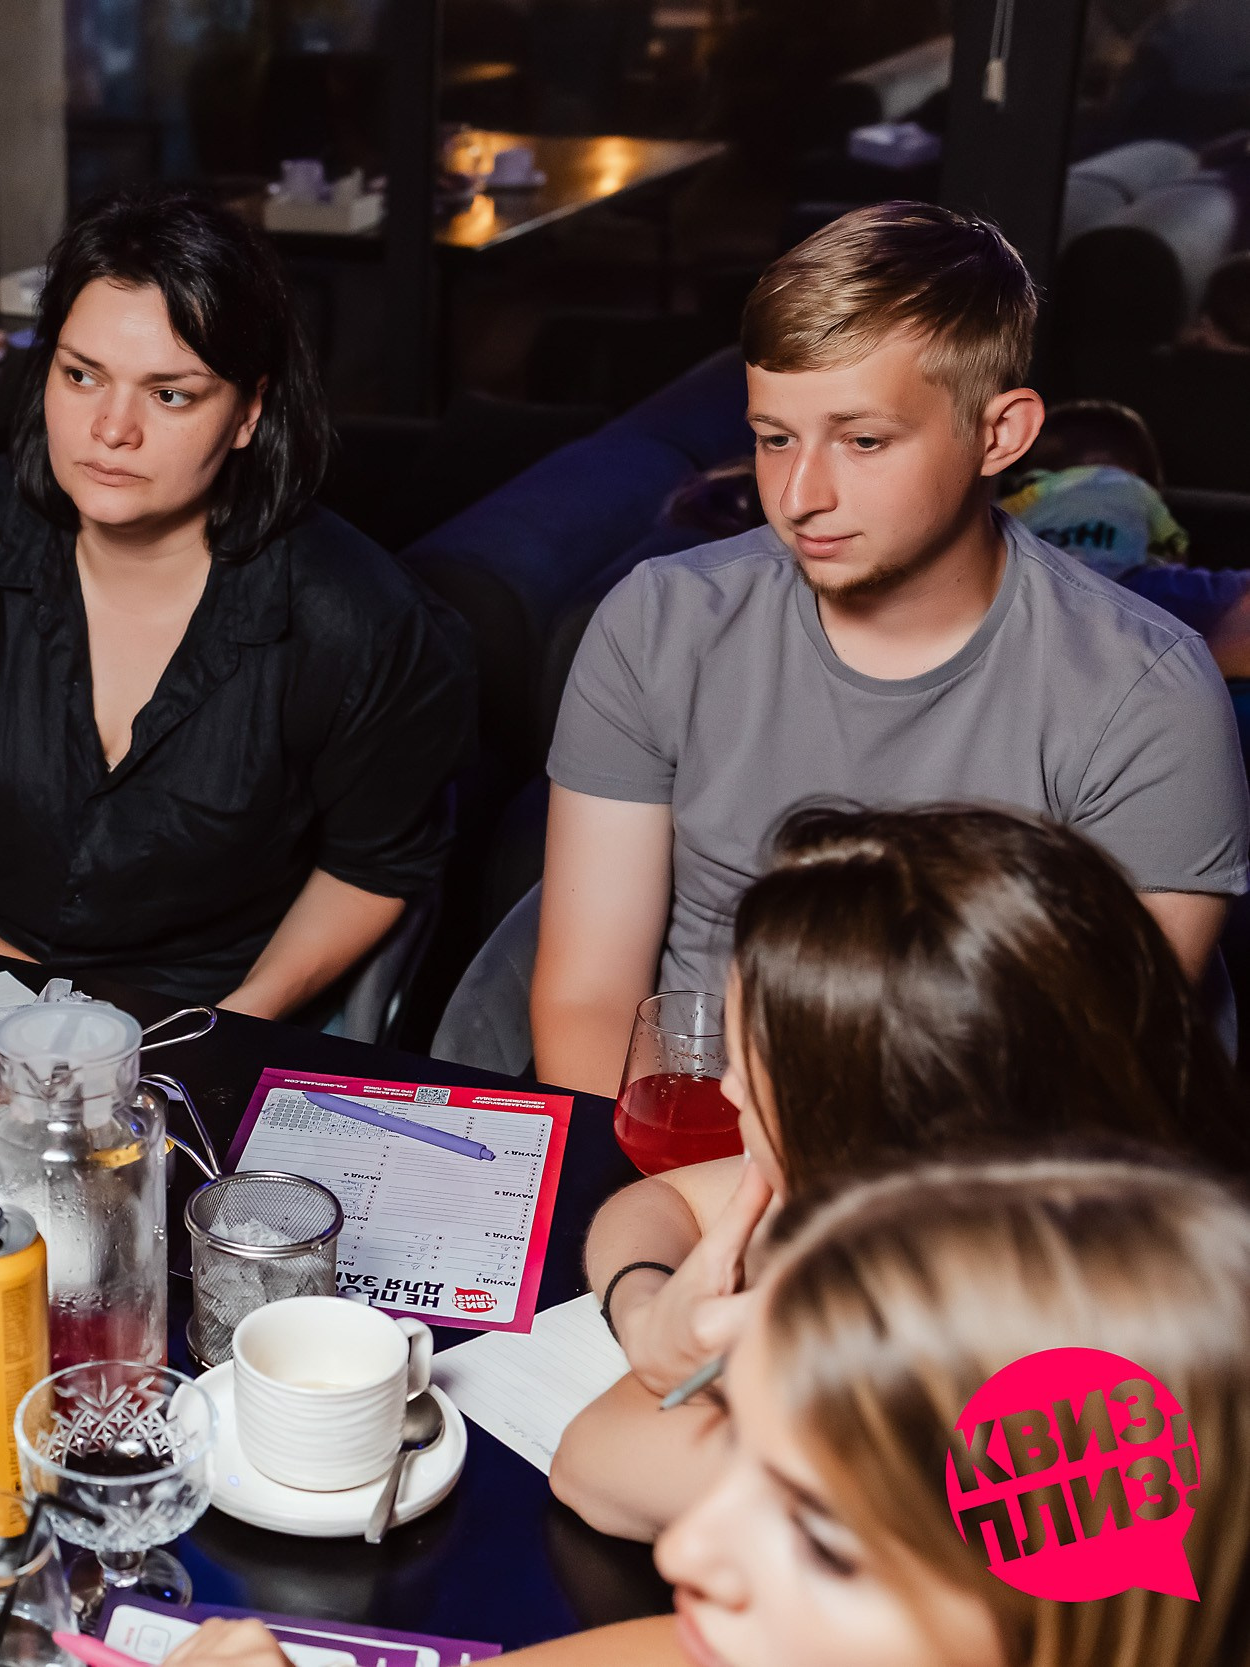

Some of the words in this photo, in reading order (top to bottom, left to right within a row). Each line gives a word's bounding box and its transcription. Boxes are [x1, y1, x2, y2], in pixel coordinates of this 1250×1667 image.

[511, 1150, 542, 1158] РАУНД
[351, 1173, 382, 1181] РАУНД
[502, 1191, 534, 1199] РАУНД
[492, 1232, 525, 1241] РАУНД
[482, 1277, 516, 1287] РАУНД
[384, 1278, 445, 1296] ДЛЯ
[404, 1293, 440, 1308] НЕ
